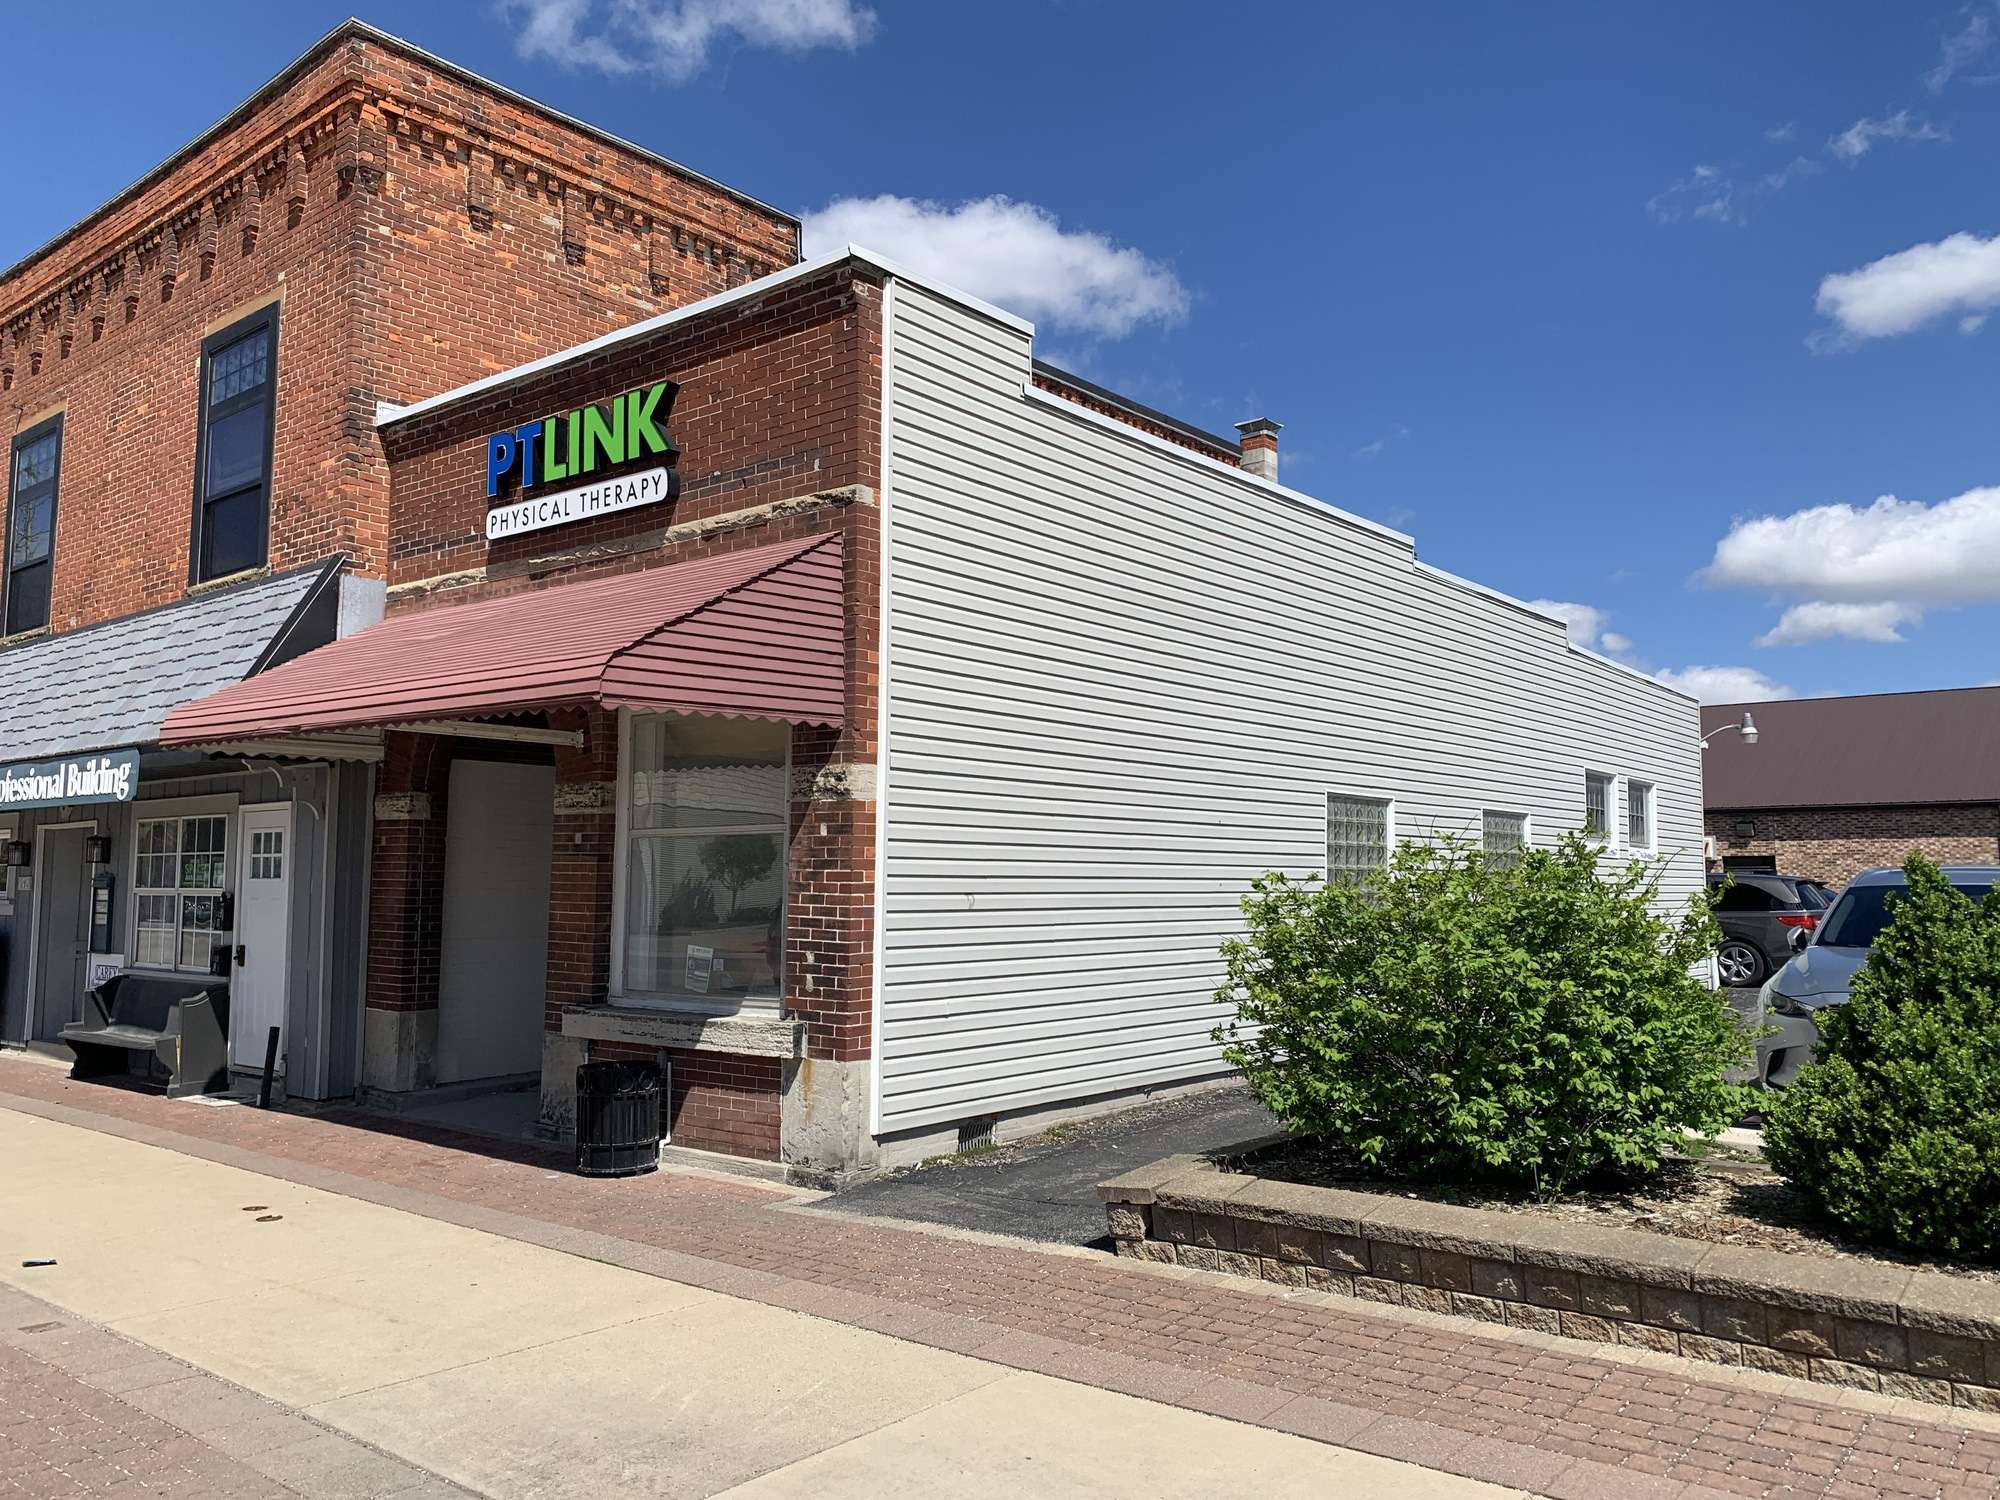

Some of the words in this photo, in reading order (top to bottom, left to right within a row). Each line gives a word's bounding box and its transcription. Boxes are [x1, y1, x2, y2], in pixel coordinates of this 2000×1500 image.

[490, 497, 570, 534] PHYSICAL
[579, 474, 662, 513] THERAPY
[67, 756, 132, 801] Building
